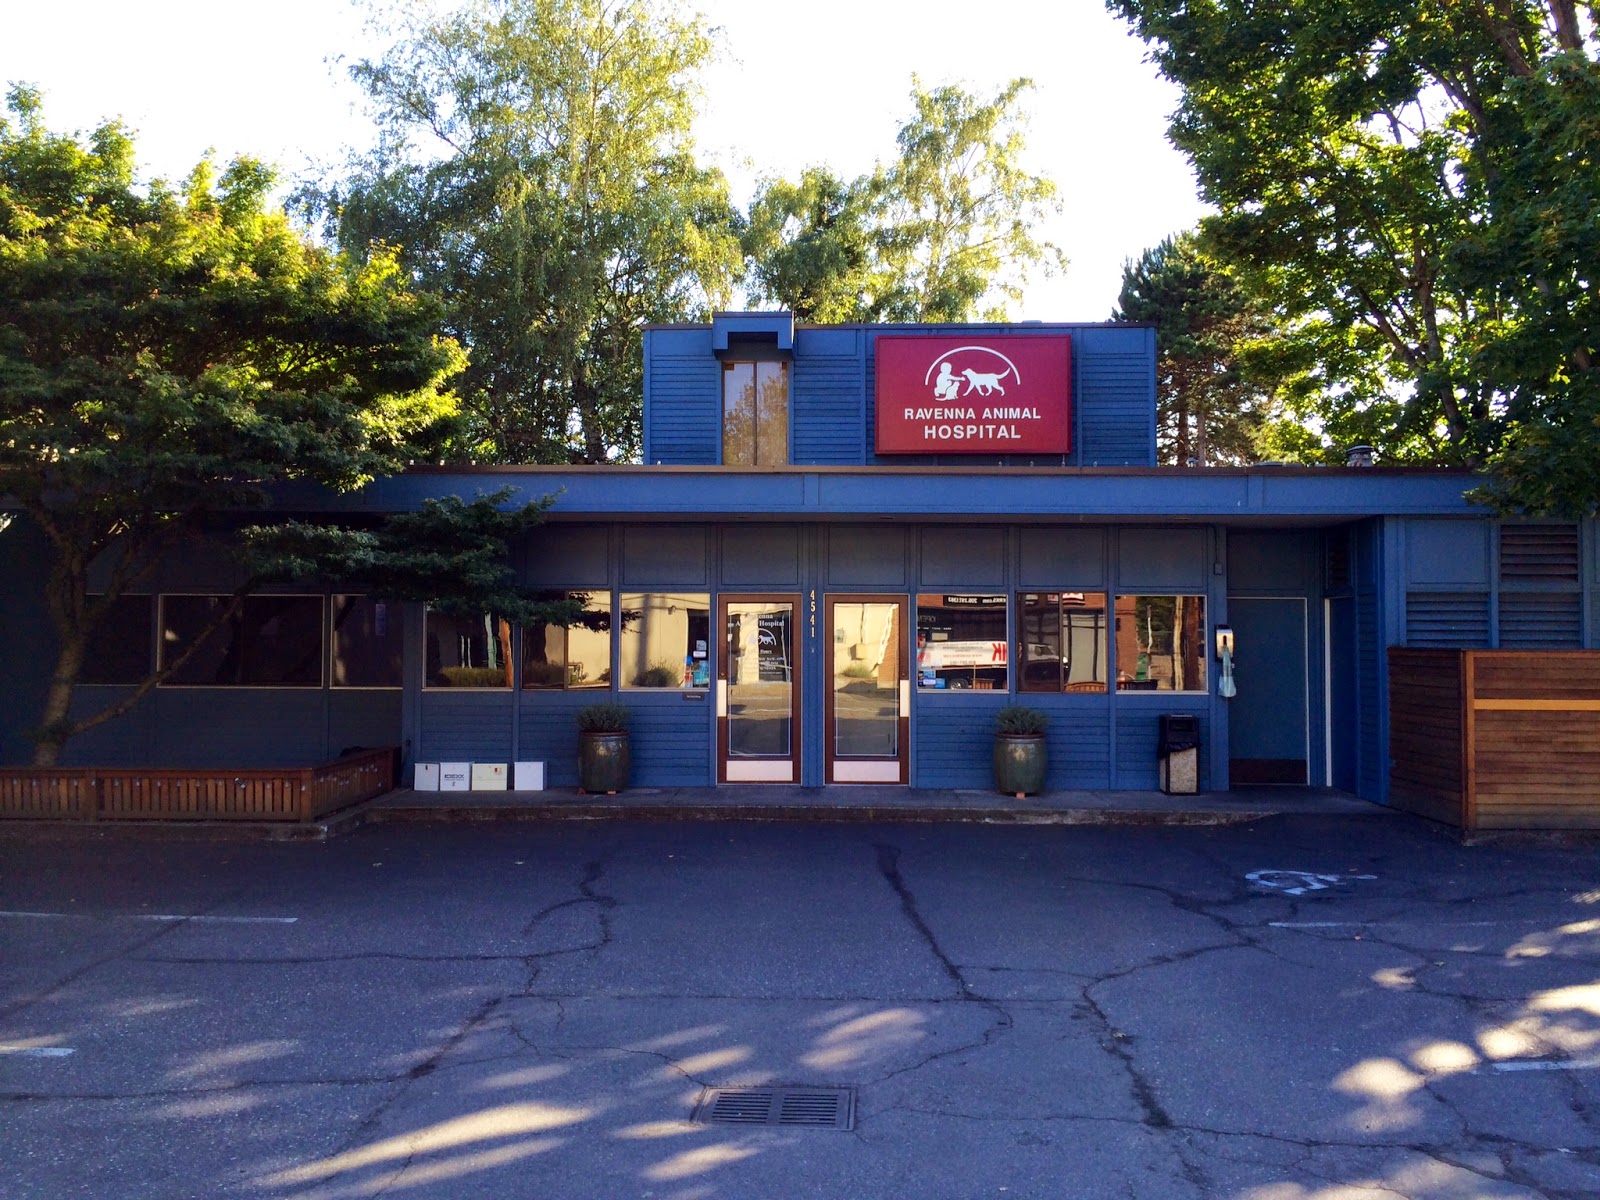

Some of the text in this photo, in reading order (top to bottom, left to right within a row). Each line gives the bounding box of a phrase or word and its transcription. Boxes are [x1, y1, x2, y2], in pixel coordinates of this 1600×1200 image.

[904, 407, 1041, 420] RAVENNA ANIMAL
[924, 425, 1021, 439] HOSPITAL
[759, 620, 785, 628] Hospital
